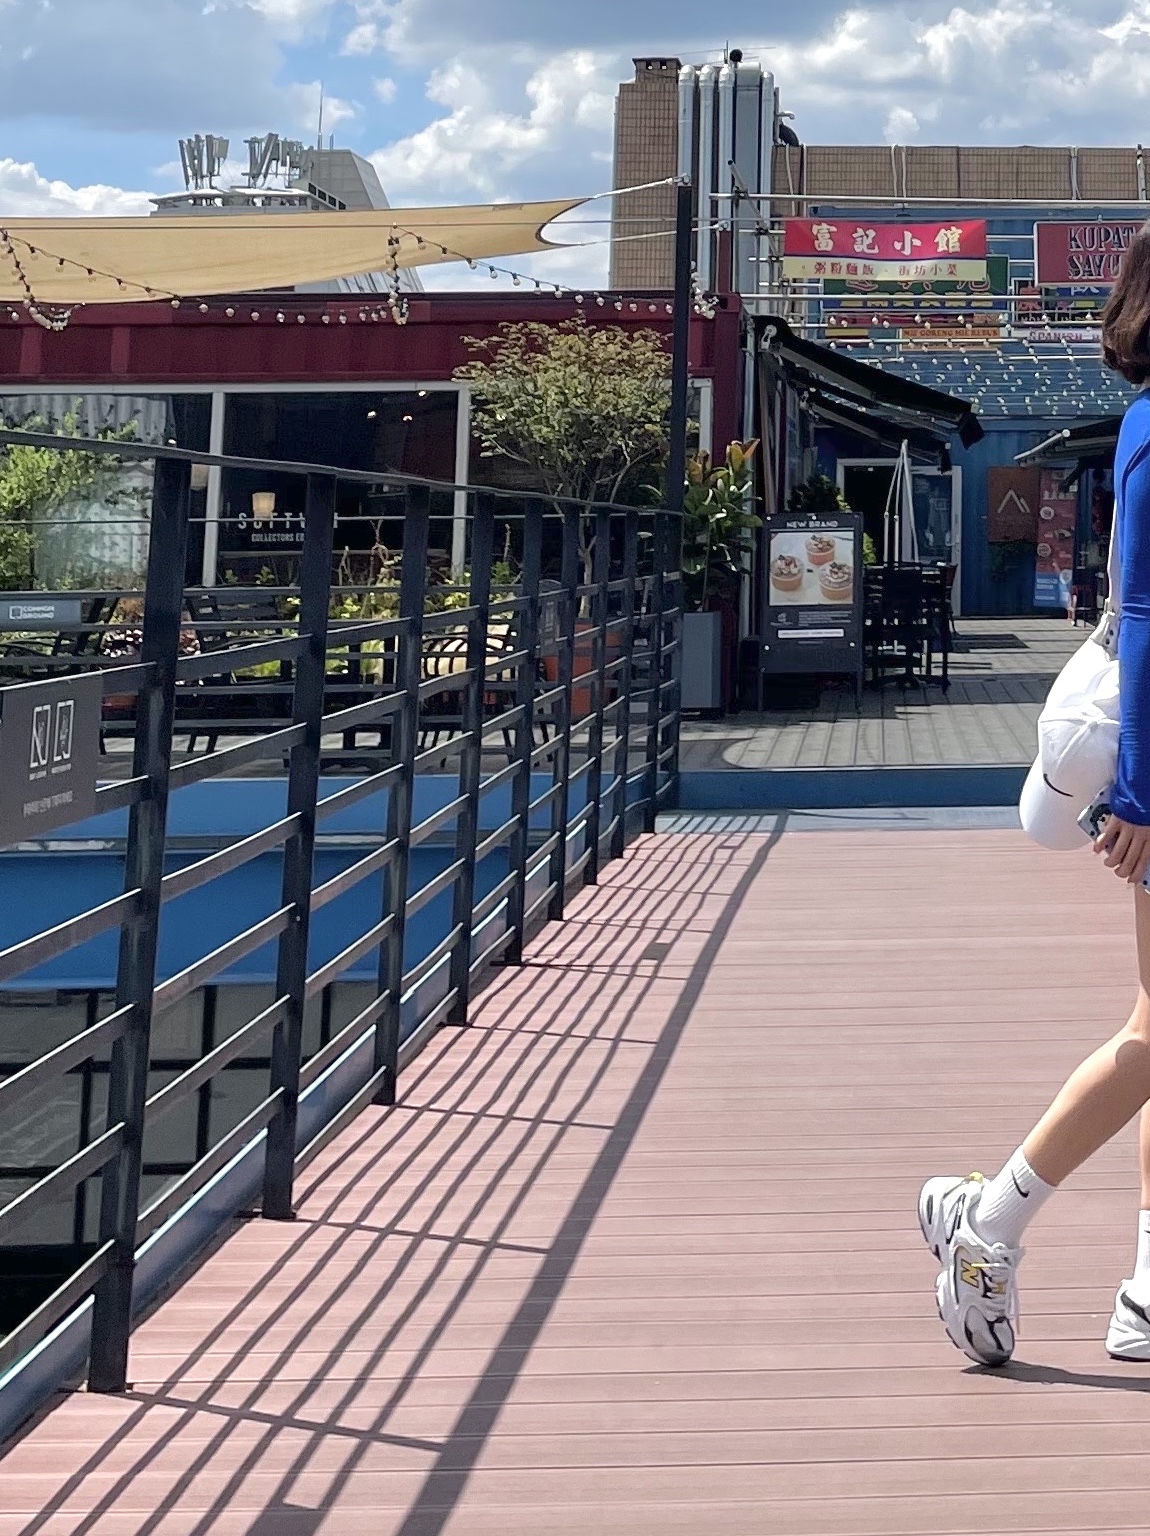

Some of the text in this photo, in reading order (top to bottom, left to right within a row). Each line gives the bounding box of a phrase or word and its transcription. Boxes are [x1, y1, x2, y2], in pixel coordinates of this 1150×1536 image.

[811, 222, 964, 255] 富記小館
[1066, 253, 1122, 280] SAYU
[786, 520, 839, 529] NEW BRAND
[251, 533, 295, 543] COLLECTORS
